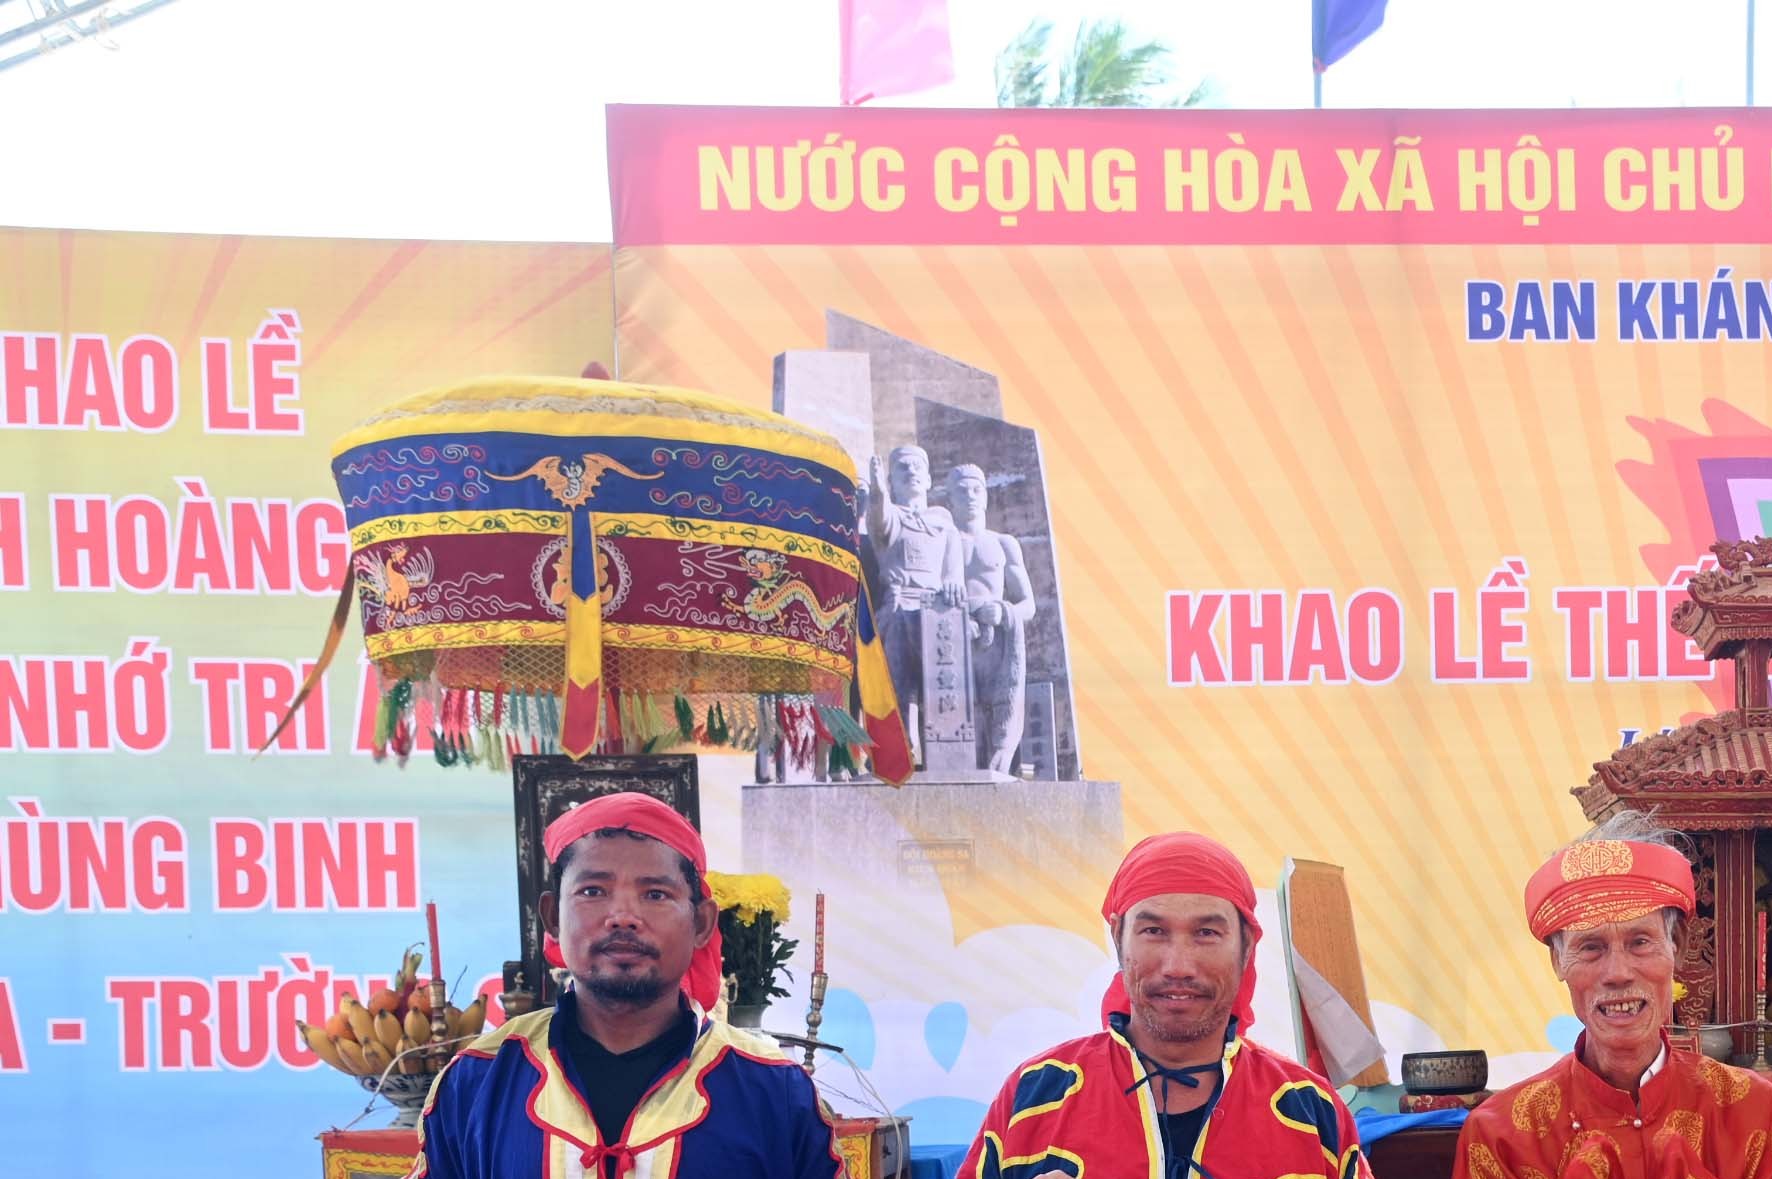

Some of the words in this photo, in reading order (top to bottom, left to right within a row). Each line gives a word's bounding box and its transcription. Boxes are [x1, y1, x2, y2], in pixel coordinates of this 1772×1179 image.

[697, 132, 906, 213] NƯỚC
[933, 134, 1138, 227] CỘNG
[1164, 133, 1313, 213] HÒA
[1335, 136, 1436, 213] XÃ
[1457, 134, 1576, 227] HỘI
[1603, 124, 1746, 213] CHỦ
[1466, 280, 1596, 341] BAN
[0, 335, 178, 433] HAO
[203, 310, 305, 433] LỀ
[53, 478, 350, 594] HOÀNG
[1168, 590, 1402, 686] KHAO
[1431, 557, 1531, 682] LỀ
[0, 643, 174, 754] NHỚ
[192, 658, 329, 754] TRI
[0, 801, 186, 909] ÙNG
[214, 819, 418, 910] BINH
